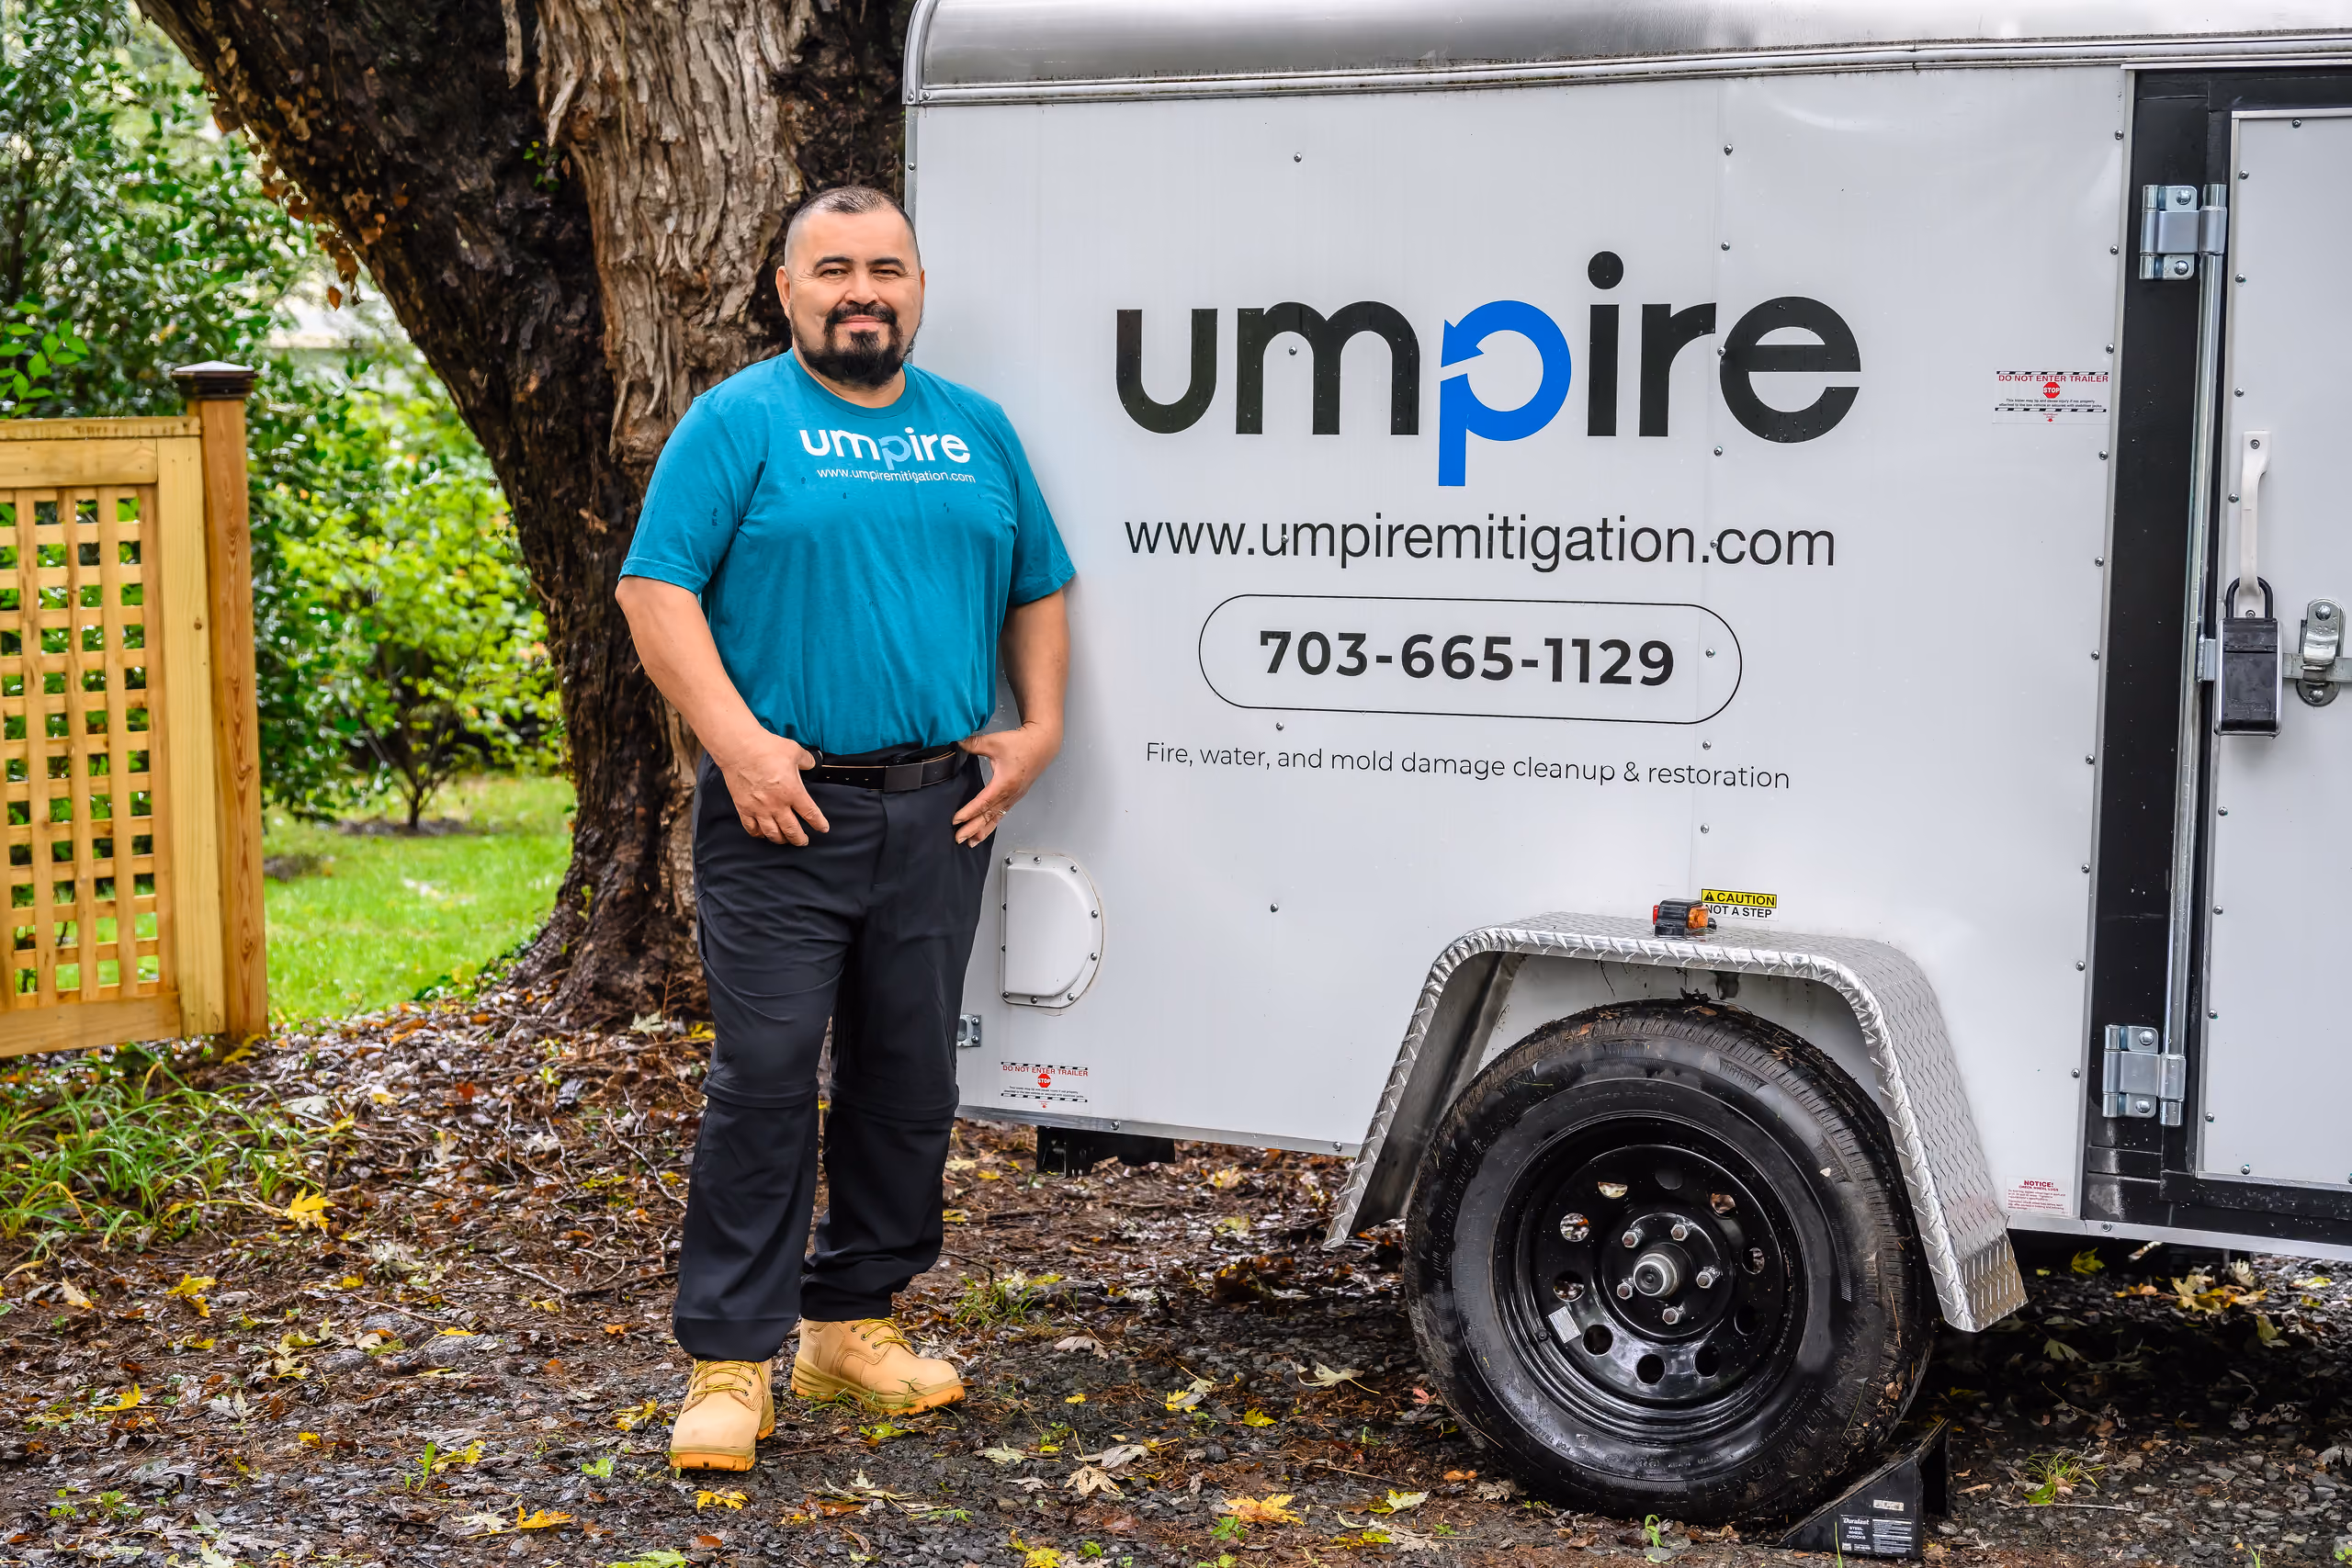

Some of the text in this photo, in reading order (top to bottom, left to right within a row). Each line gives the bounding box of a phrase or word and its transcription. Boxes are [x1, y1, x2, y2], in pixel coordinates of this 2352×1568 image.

[1115, 251, 1861, 487] umpire
[798, 426, 971, 471] umpire
[816, 468, 977, 484] www.umpiremitigation.com
[1124, 512, 1836, 573] www.umpiremitigation.com
[1260, 630, 1675, 687] 703-665-1129
[1146, 741, 1791, 790] Fire, water, and mold damage cleanup & restoration
[1705, 904, 1772, 919] NOT A STEP
[1716, 892, 1775, 906] CAUTION
[1031, 1066, 1056, 1075] ENTER
[1057, 1068, 1089, 1077] TRAILER
